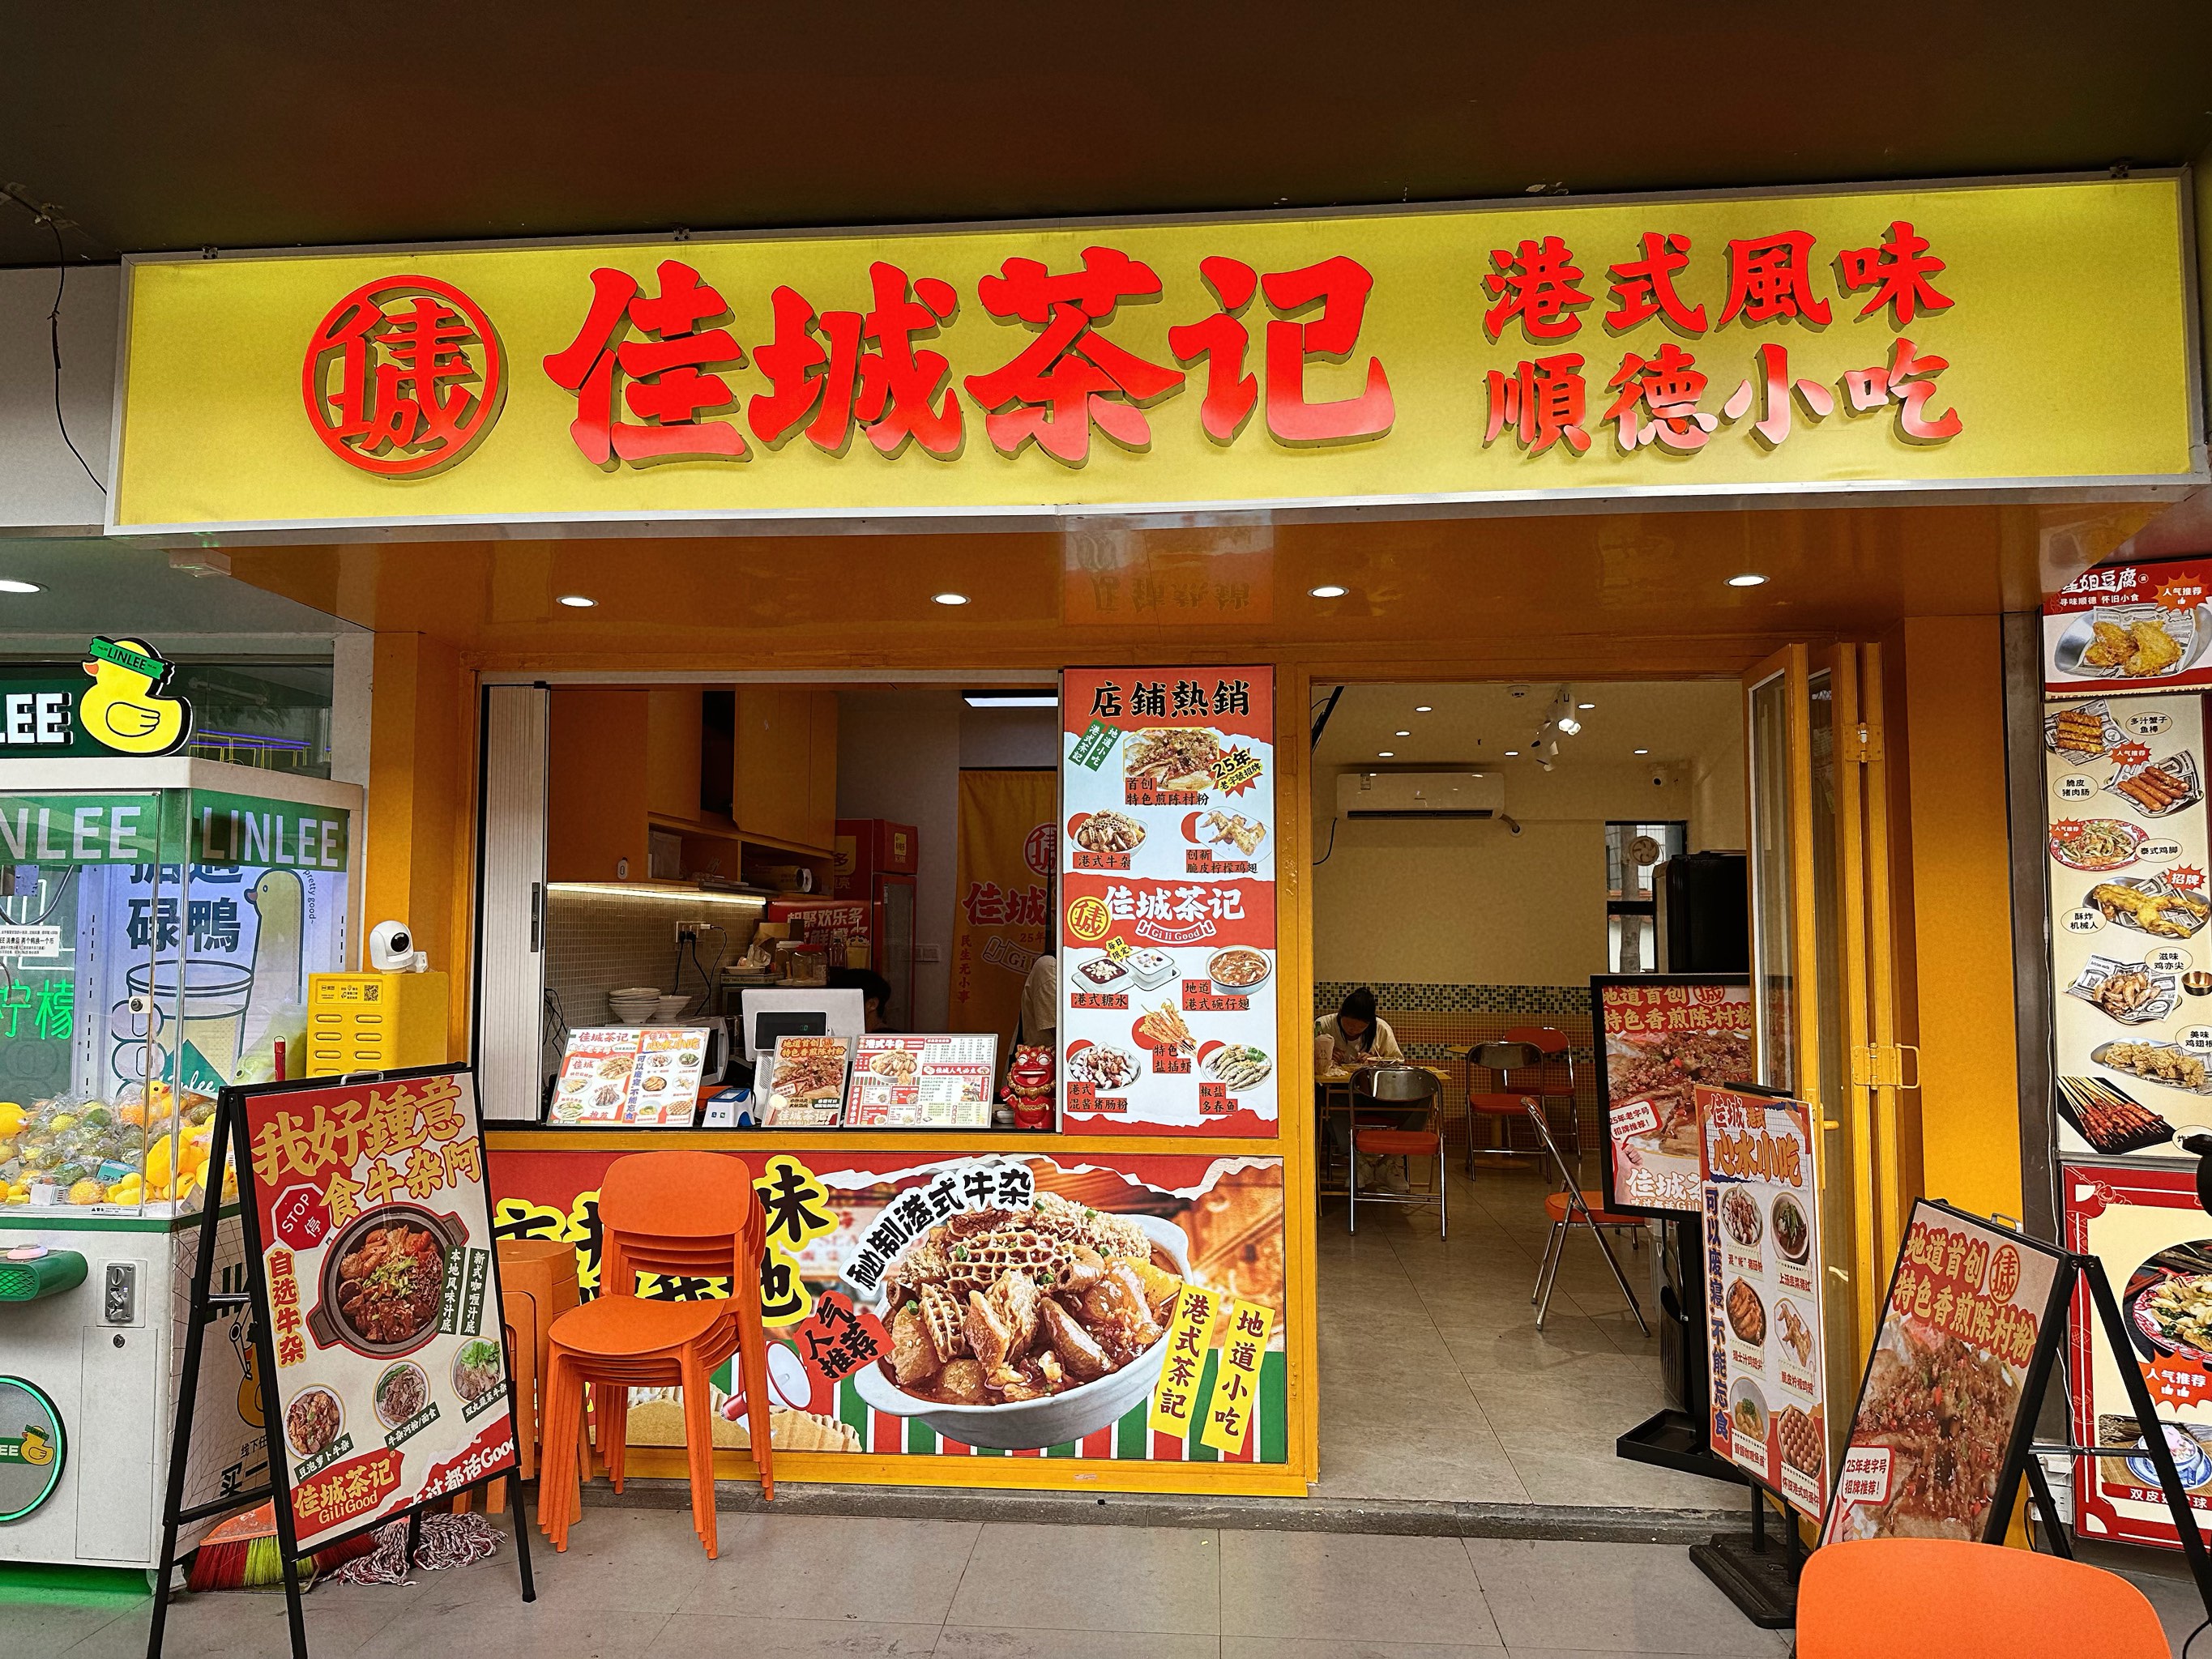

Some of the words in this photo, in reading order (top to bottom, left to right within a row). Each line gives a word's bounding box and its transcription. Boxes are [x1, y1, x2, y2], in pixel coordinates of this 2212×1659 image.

[1484, 221, 1955, 340] 港式風味
[544, 246, 1395, 467] 佳城茶记
[1484, 338, 1963, 457] 順德小吃
[2060, 595, 2097, 607] 寻味顺德
[2102, 593, 2139, 604] 怀旧小食
[2162, 586, 2202, 597] 人气推荐
[107, 646, 147, 671] LINLEE
[1089, 680, 1250, 718] 店鋪熱銷
[0, 693, 72, 744] EE
[2130, 716, 2167, 726] 多汁蟹子
[1091, 727, 1119, 767] 地道小吃
[2116, 748, 2146, 757] 人气推荐
[1212, 749, 1251, 778] 25年
[1126, 778, 1153, 791] 首创
[2062, 787, 2090, 797] 猪肉肠
[2066, 779, 2086, 787] 脆皮
[1127, 793, 1210, 806] 特色煎陈村粉
[203, 807, 339, 868] LINLEE
[1187, 850, 1211, 860] 创新
[2141, 846, 2178, 855] 泰式鸡脚
[1078, 855, 1131, 868] 港式牛杂
[1187, 863, 1258, 874] 脆皮柠檬鸡翅
[303, 869, 316, 896] pretty
[2171, 873, 2201, 886] 招牌
[1104, 885, 1245, 922] 佳城茶记
[2069, 920, 2099, 930] 机械人
[2074, 912, 2094, 921] 酥炸
[1175, 928, 1201, 940] Good
[1108, 938, 1123, 951] 每日
[2159, 952, 2179, 961] 滋味
[1185, 982, 1210, 995] 地道
[1603, 986, 1688, 1006] 地道首创
[1074, 994, 1127, 1008] 港式糖水
[1185, 997, 1250, 1010] 港式碗仔翅
[579, 1032, 629, 1043] 佳城茶记
[2189, 1030, 2210, 1039] 美味
[1154, 1044, 1178, 1056] 特色
[1069, 1083, 1091, 1095] 港式
[1200, 1085, 1223, 1097] 椒盐
[1070, 1098, 1128, 1111] 混酱猪肠粉
[1202, 1100, 1236, 1113] 多春鱼
[1710, 1094, 1744, 1128] 佳城
[251, 1077, 466, 1186] 我好鍾意
[1714, 1128, 1804, 1188] 心水小吃
[282, 1192, 311, 1235] STOP
[305, 1216, 322, 1238] 停
[847, 1167, 1033, 1291] 秘制港式牛杂
[1904, 1227, 1988, 1291] 地道首创
[441, 1247, 461, 1333] 本地风味汁底
[463, 1251, 485, 1335] 新式咖喱汁底
[269, 1250, 305, 1365] 自选牛杂
[1894, 1269, 2037, 1363] 特色香煎陈村粉
[808, 1296, 852, 1359] 人气
[820, 1321, 879, 1379] 推荐
[1160, 1292, 1211, 1419] 港式茶記
[1215, 1309, 1265, 1437] 地道小吃
[2146, 1366, 2206, 1388] 人气推荐
[298, 1439, 351, 1481] 豆泡萝卜牛杂
[1846, 1457, 1887, 1475] 25年老字号
[294, 1457, 395, 1519] 佳城茶记
[1845, 1478, 1881, 1496] 招牌推荐!
[2130, 1487, 2208, 1510] 双皮球
